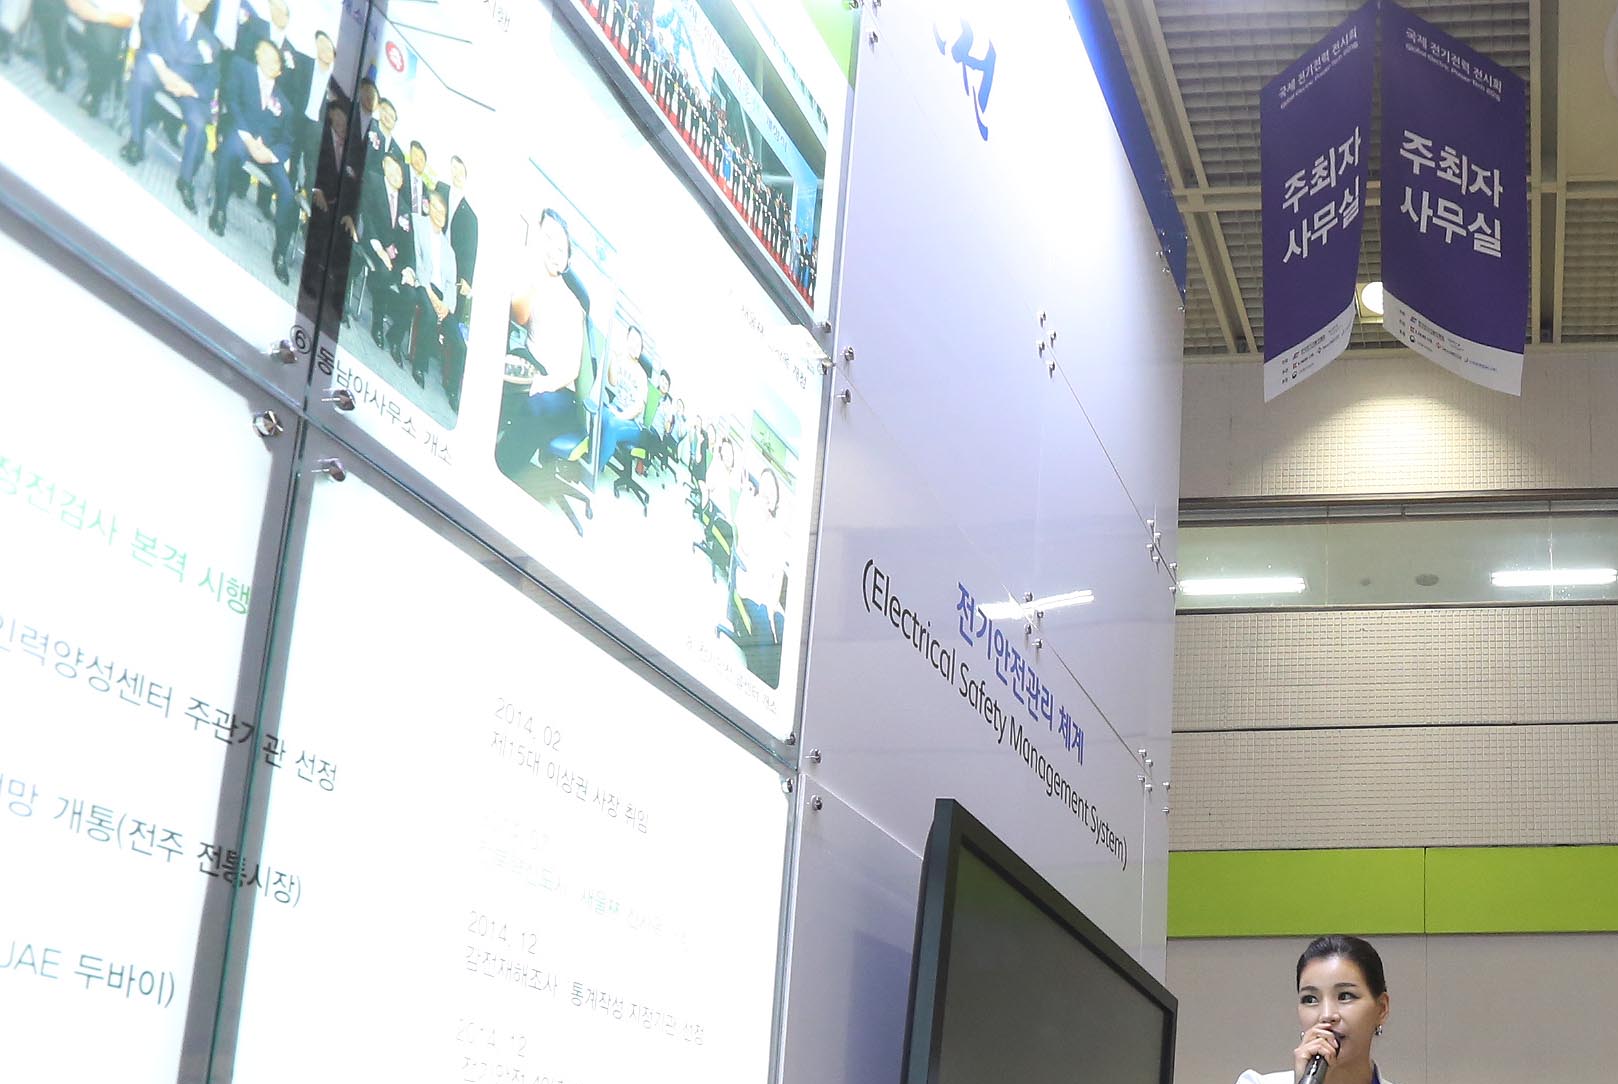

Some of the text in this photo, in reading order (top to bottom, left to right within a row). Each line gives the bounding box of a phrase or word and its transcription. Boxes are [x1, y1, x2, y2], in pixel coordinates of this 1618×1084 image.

[1282, 126, 1361, 215] 주최자
[1400, 129, 1504, 209] 주최자
[1282, 176, 1360, 264] 사무실
[1400, 186, 1503, 258] 사무실
[317, 346, 416, 439] 동남아사무소
[424, 432, 452, 466] 개소
[131, 528, 191, 583] 본격
[197, 565, 251, 616] 시행
[957, 581, 1085, 766] 전기안전관리 체계
[543, 724, 562, 752] 02
[862, 559, 1128, 871] (Electrical Safety Management System)
[296, 750, 337, 791] 선정
[593, 788, 621, 818] 사장
[73, 953, 176, 1008] 두바이)
[520, 931, 537, 955] 12
